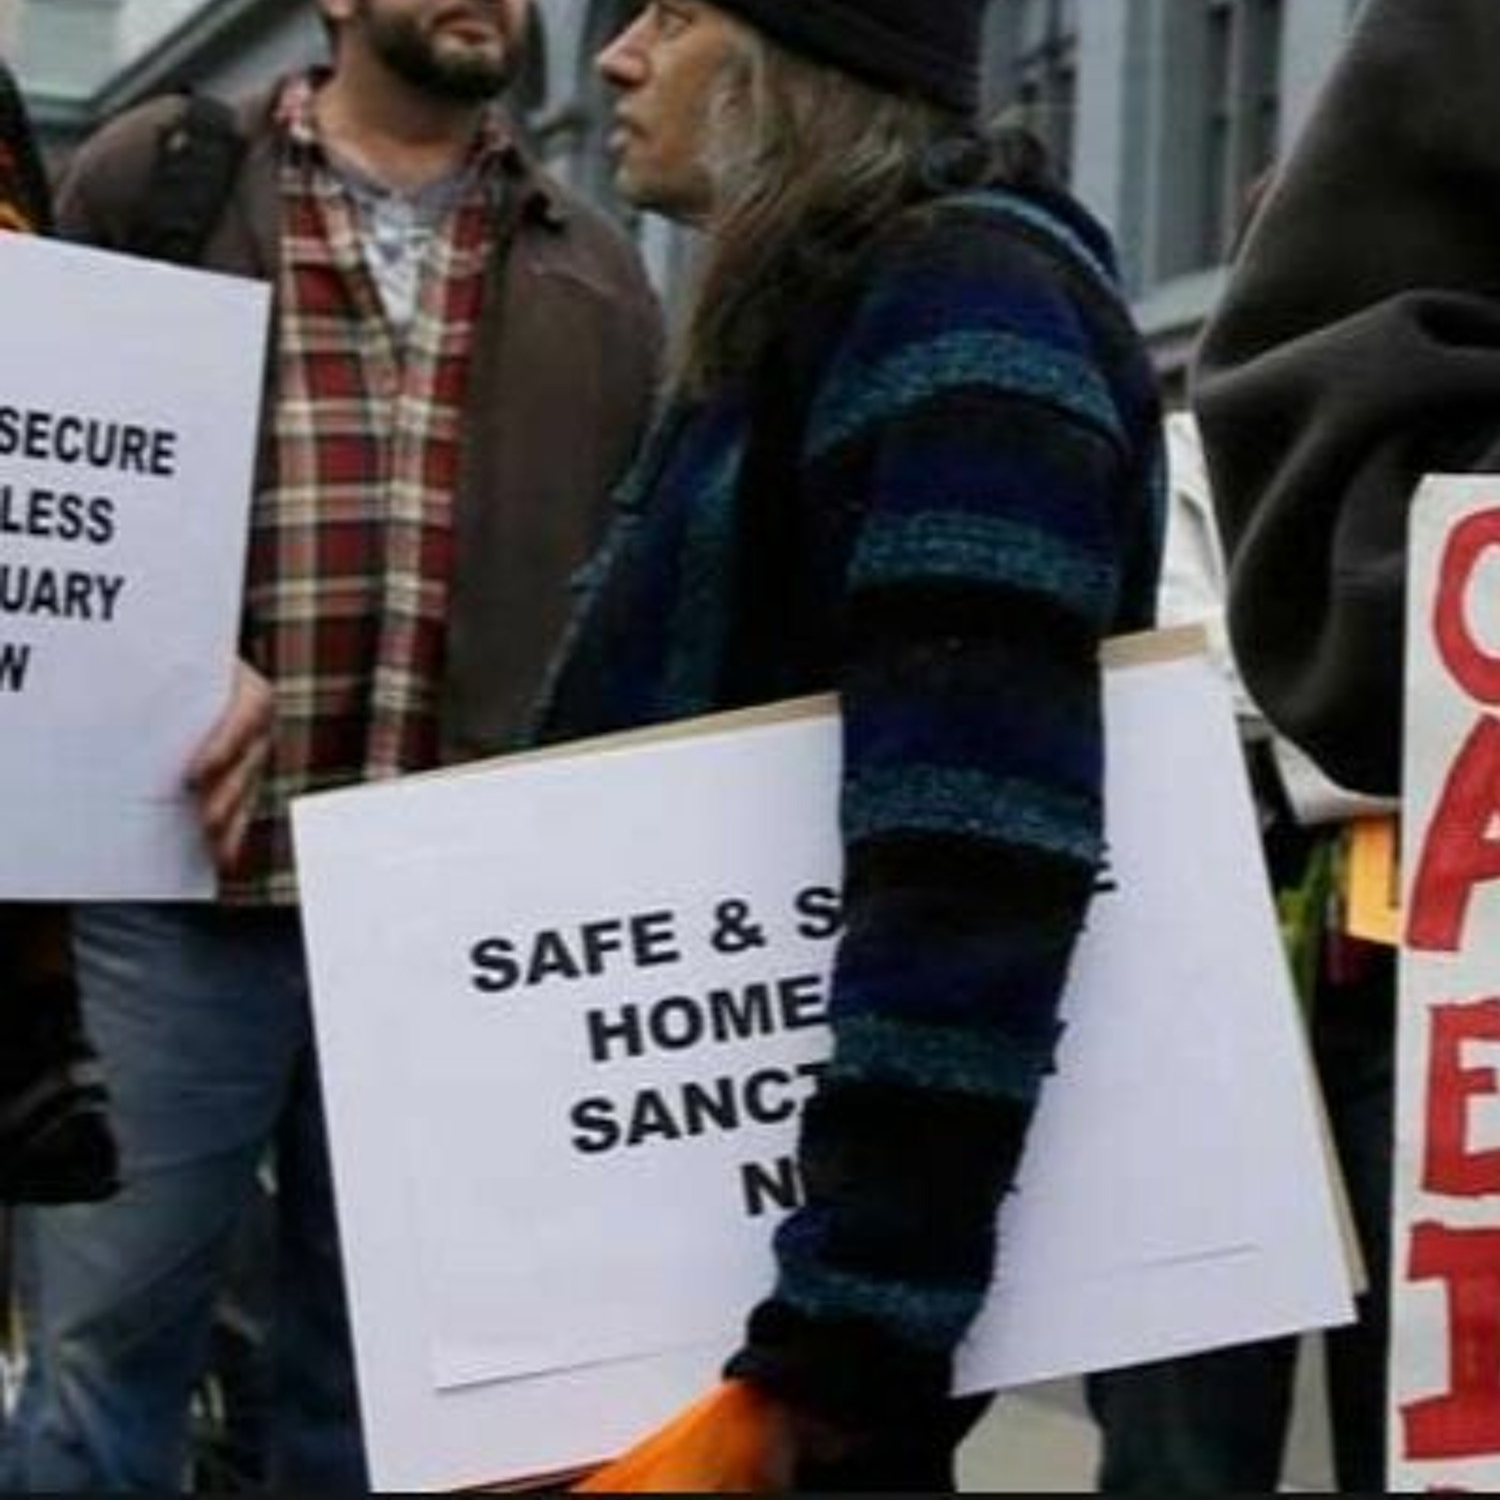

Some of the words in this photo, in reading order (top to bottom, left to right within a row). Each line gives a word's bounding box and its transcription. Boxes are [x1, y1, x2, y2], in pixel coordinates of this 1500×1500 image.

[0, 405, 178, 478] SECURE
[0, 484, 115, 546] LESS
[0, 563, 126, 622] UARY
[469, 910, 681, 994] SAFE
[709, 898, 767, 954] &
[585, 973, 829, 1063] HOME
